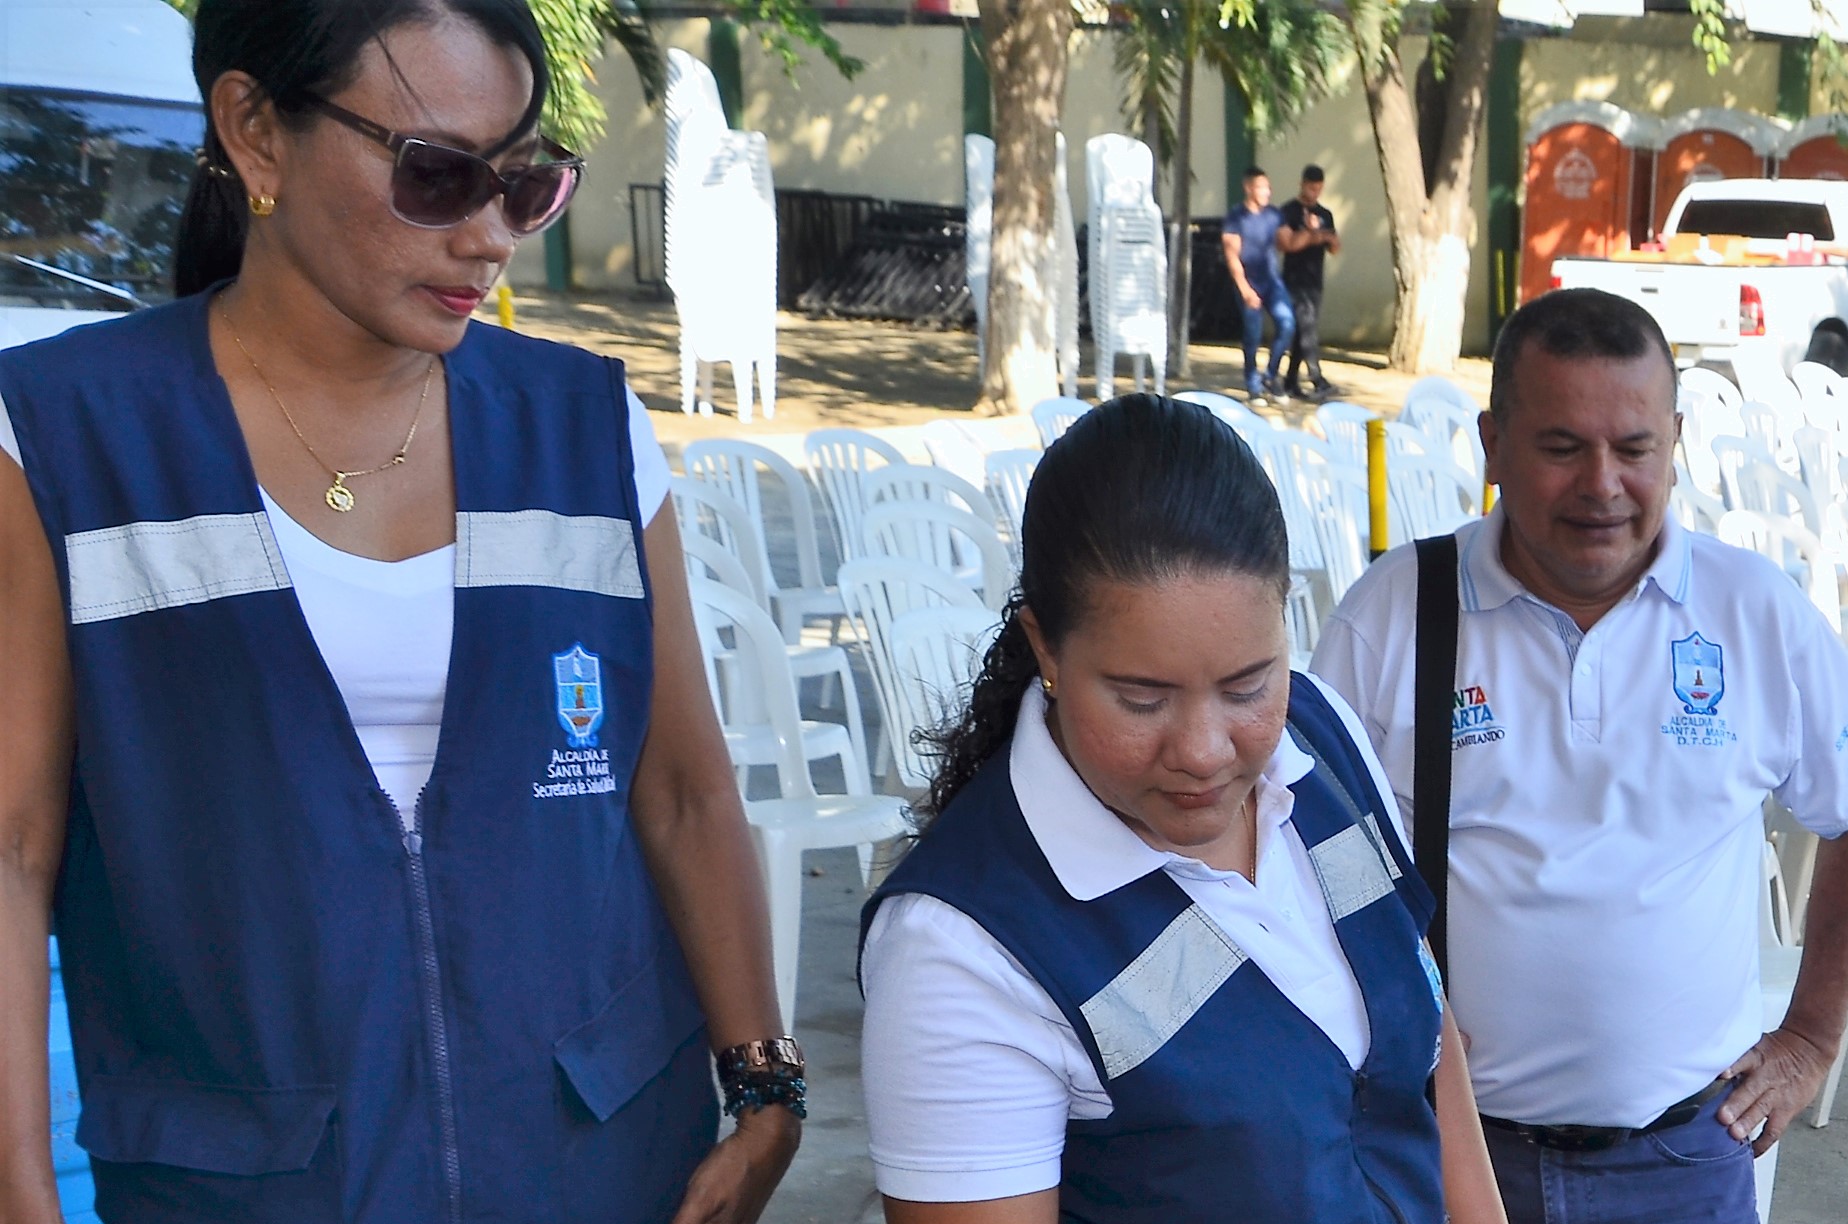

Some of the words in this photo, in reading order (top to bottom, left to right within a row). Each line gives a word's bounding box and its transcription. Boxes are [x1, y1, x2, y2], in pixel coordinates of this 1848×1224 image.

[1454, 686, 1487, 708] NTA
[1451, 704, 1493, 730] ARTA
[1661, 725, 1697, 736] SANTA
[547, 763, 583, 778] SANTA
